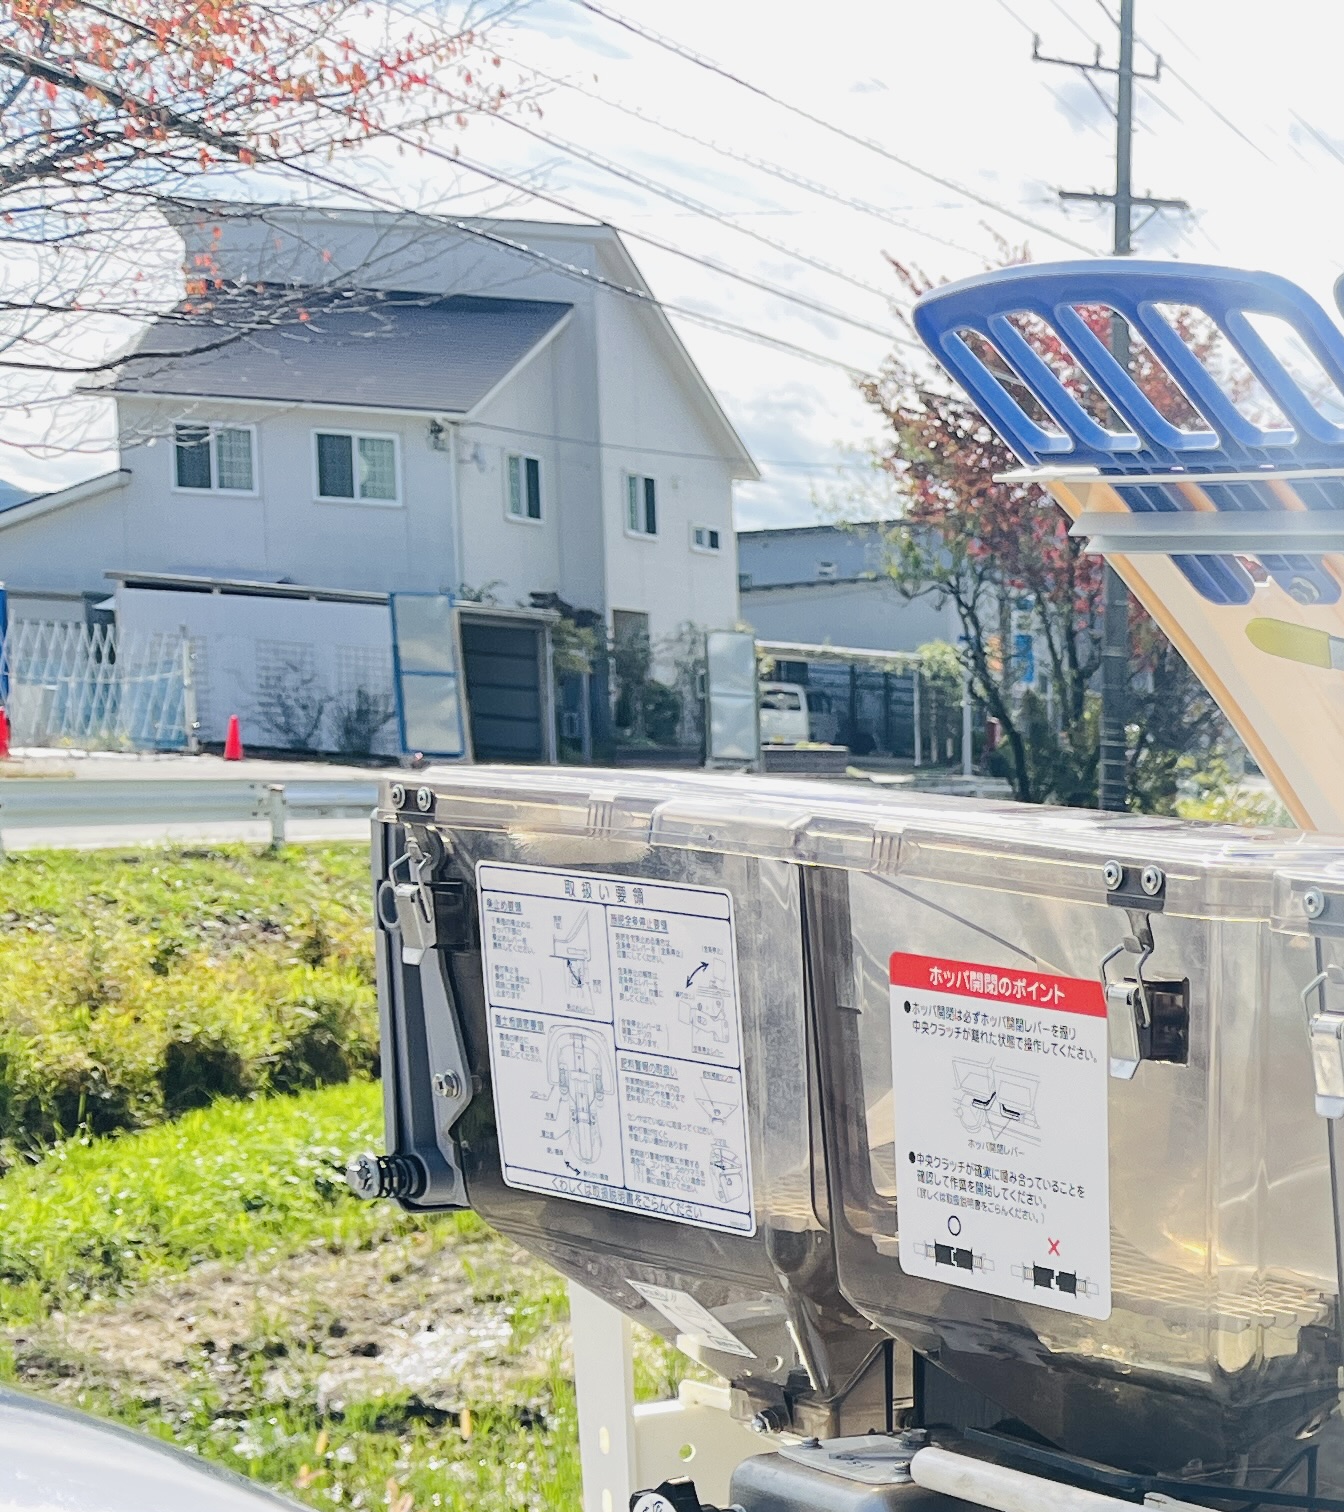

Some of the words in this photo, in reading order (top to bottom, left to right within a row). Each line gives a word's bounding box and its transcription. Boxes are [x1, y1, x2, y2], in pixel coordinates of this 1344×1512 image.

[564, 880, 645, 905] 取扱い要領
[929, 965, 1065, 1006] ホッパ開閉のポイント
[967, 1138, 1024, 1159] ホッパ開閉レバー
